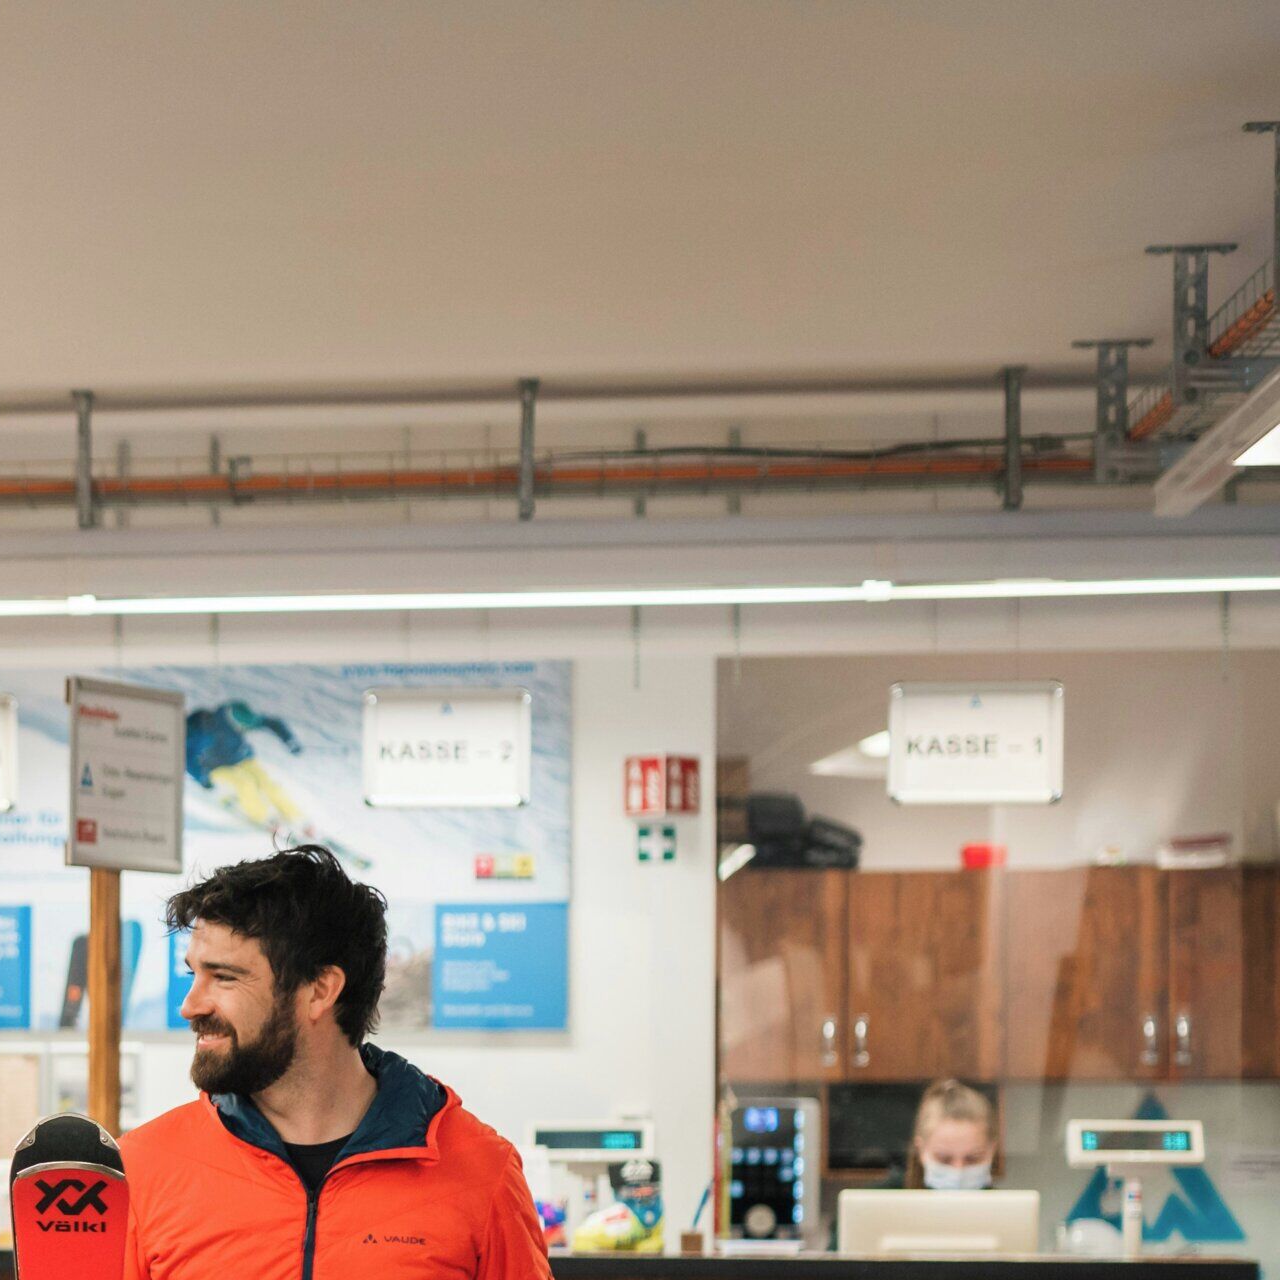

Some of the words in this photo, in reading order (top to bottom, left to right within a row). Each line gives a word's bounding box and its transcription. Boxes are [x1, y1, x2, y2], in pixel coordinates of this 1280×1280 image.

[378, 740, 469, 761] KASSE
[499, 739, 515, 760] 2
[906, 734, 997, 758] KASSE
[1034, 733, 1044, 755] 1
[384, 1236, 426, 1246] VAUDE
